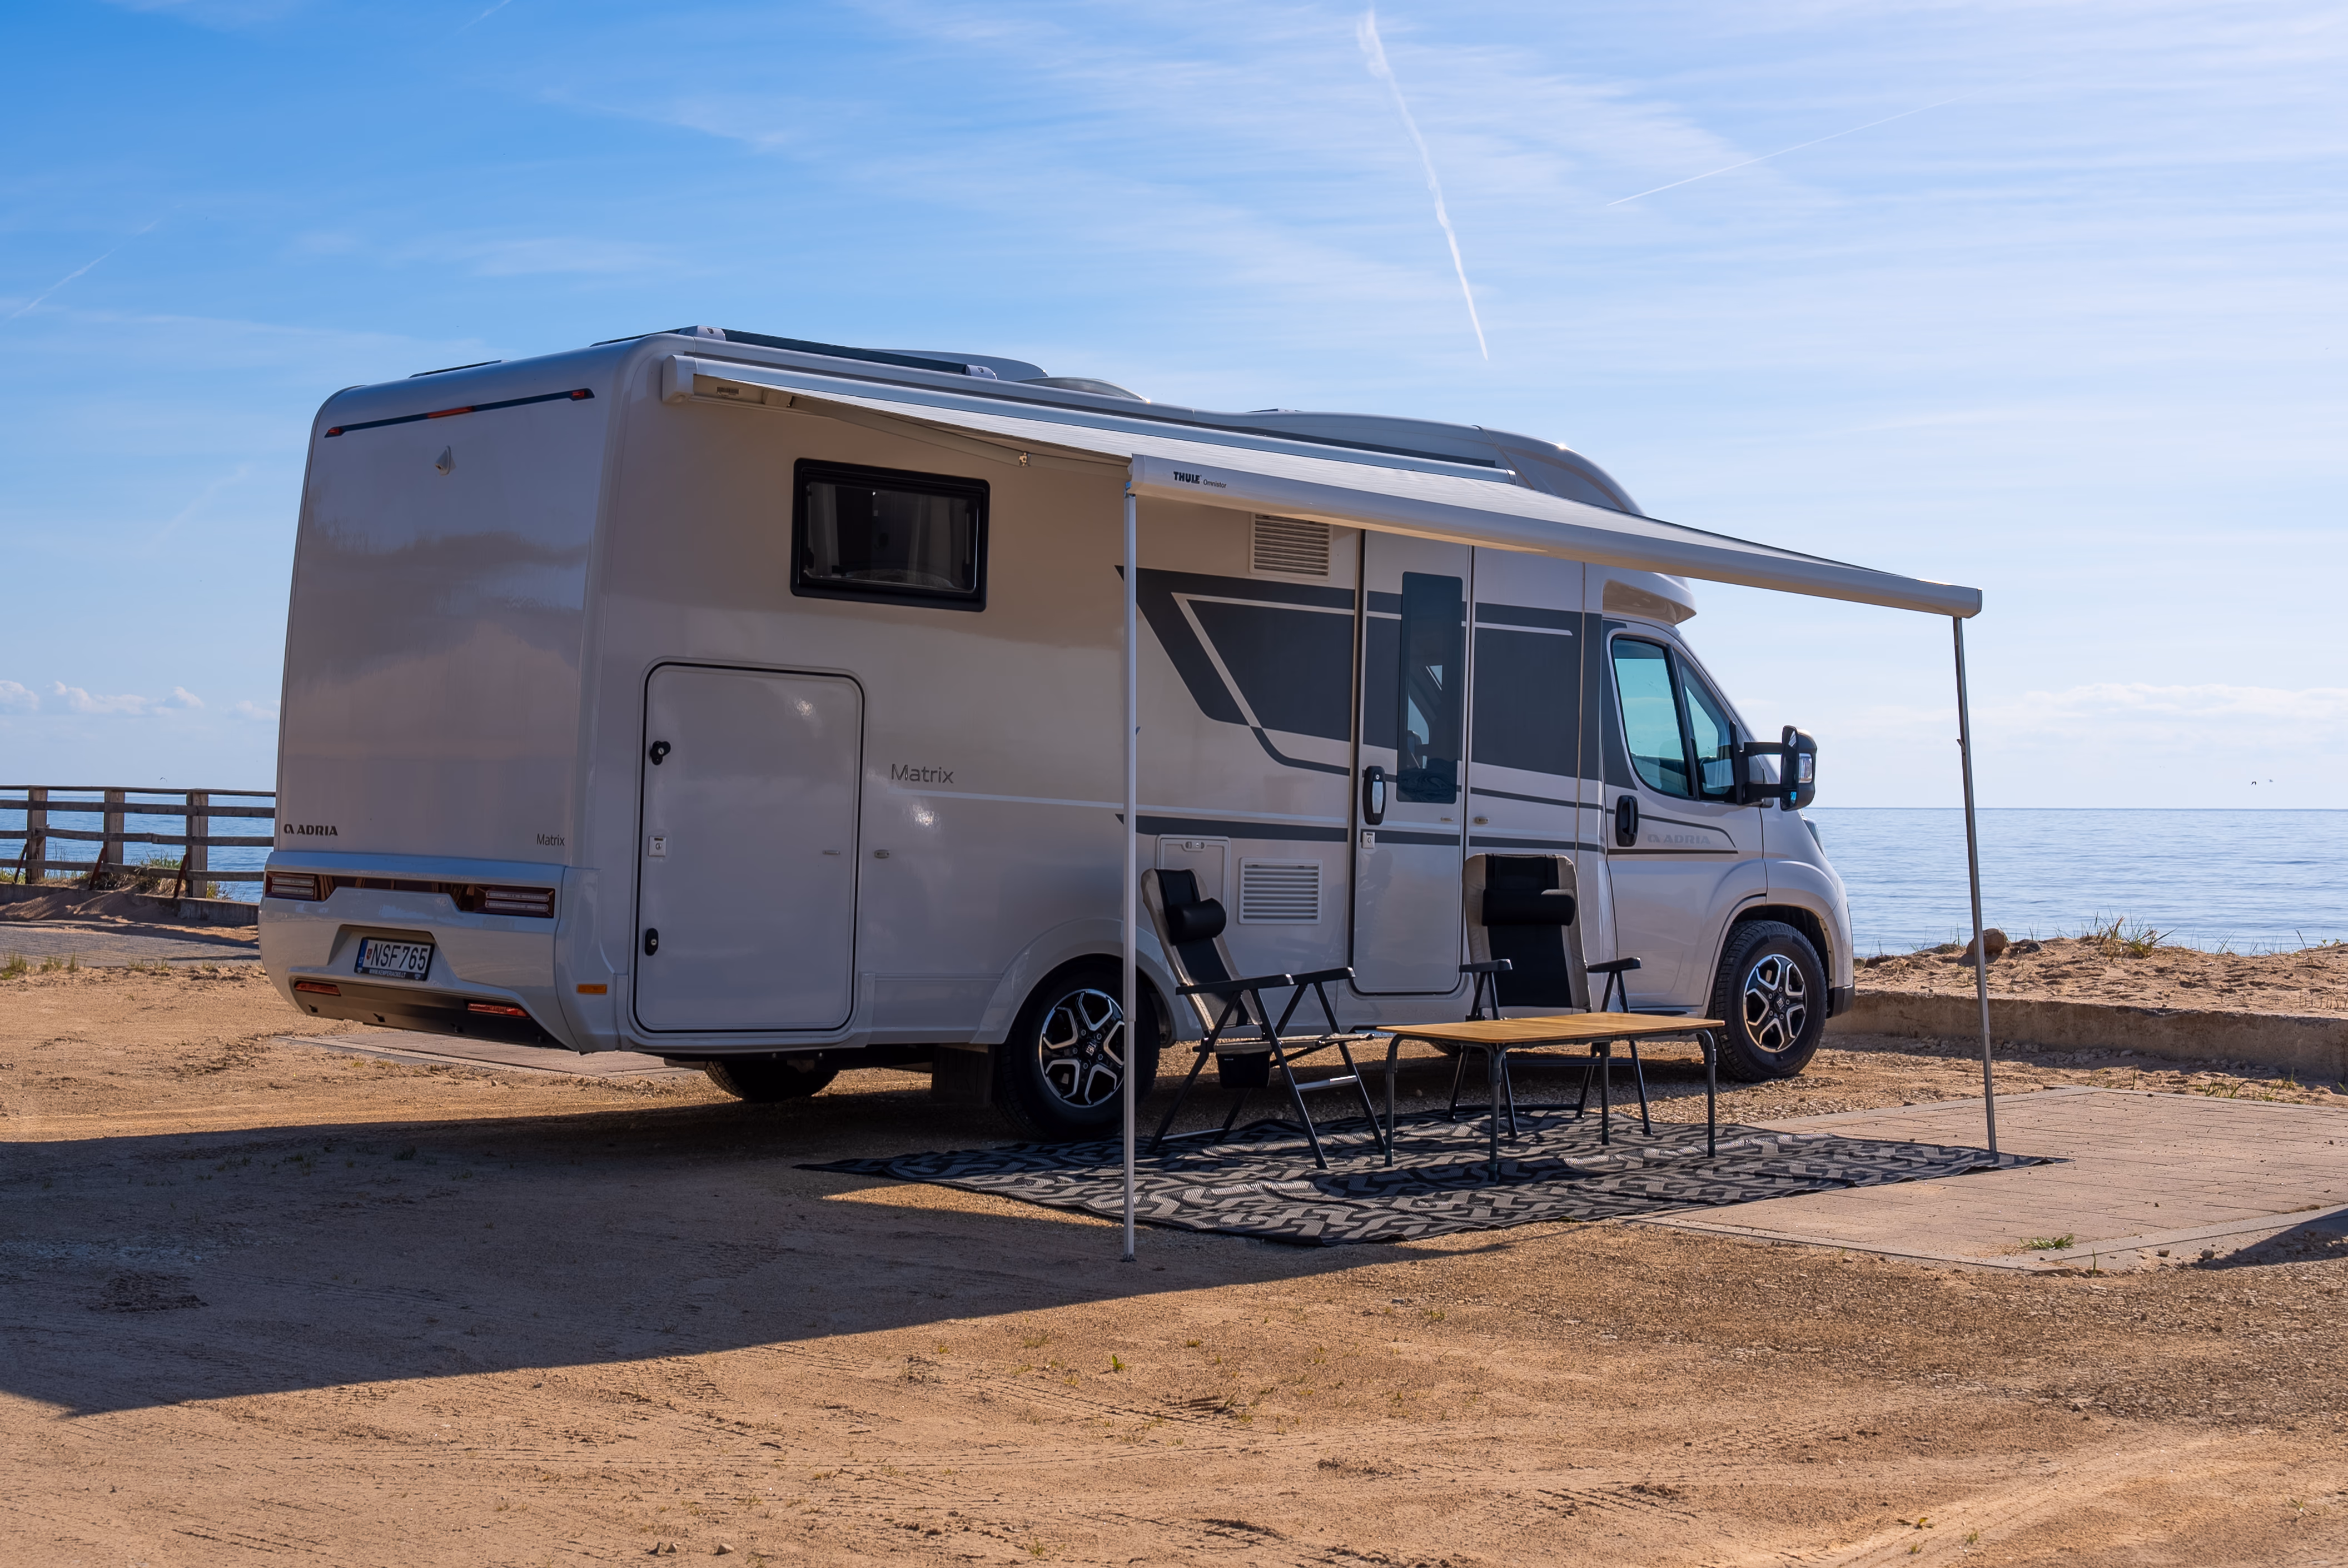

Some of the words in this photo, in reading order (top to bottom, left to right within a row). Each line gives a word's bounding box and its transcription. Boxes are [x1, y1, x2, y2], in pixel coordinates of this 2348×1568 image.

[1173, 471, 1200, 484] THULE
[1203, 479, 1227, 489] Omnistor
[891, 763, 954, 784] Matrix
[296, 824, 339, 836] ADRIA
[536, 833, 565, 847] Matrix
[1663, 834, 1711, 844] ADRIA
[370, 943, 429, 971] NSF765
